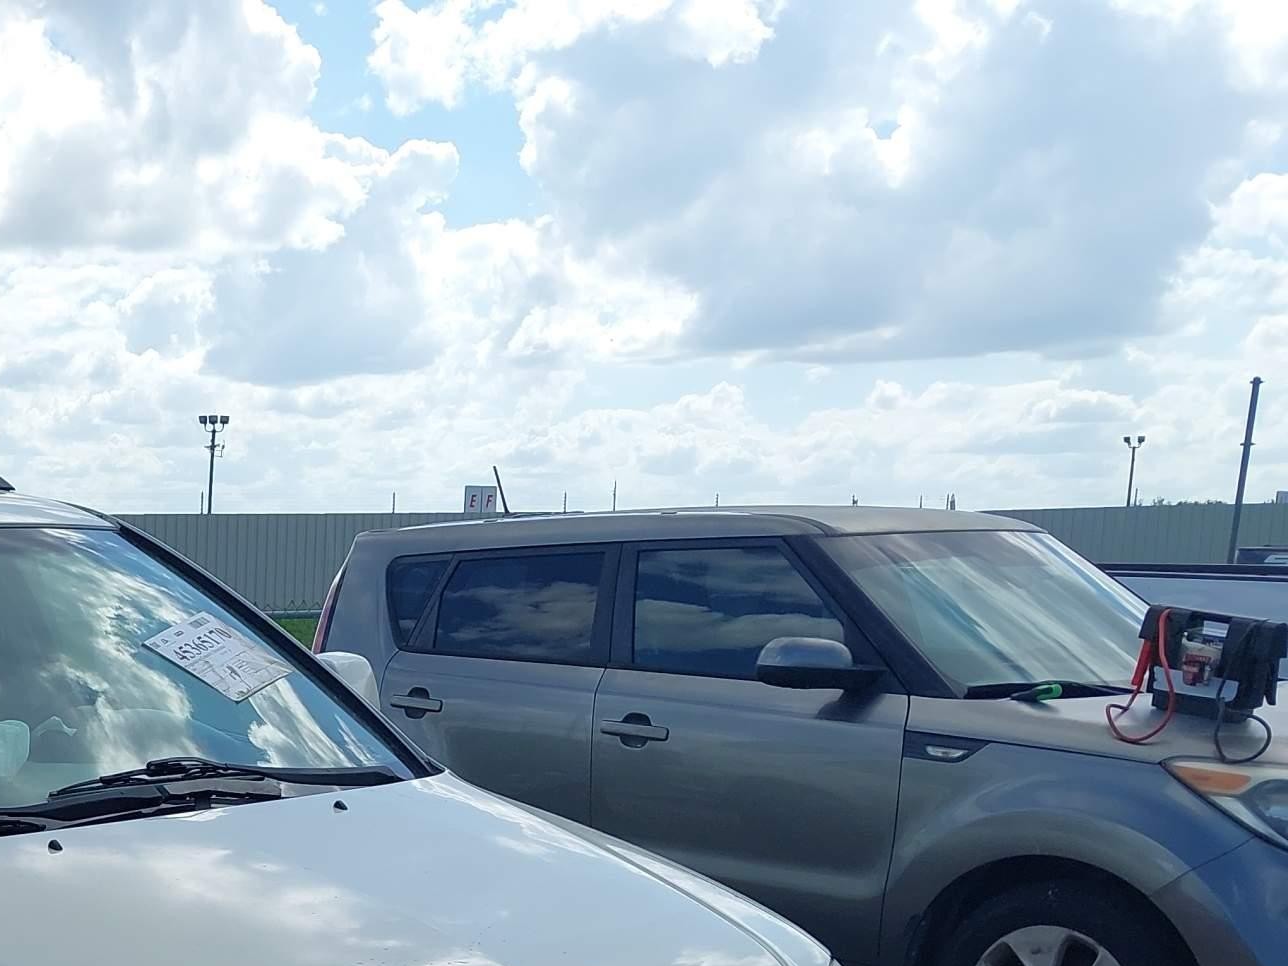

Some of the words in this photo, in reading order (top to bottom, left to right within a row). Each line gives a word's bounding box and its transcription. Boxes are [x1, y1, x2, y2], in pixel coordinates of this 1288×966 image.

[469, 494, 478, 508] E
[485, 494, 494, 508] F
[173, 628, 232, 662] 45365170
